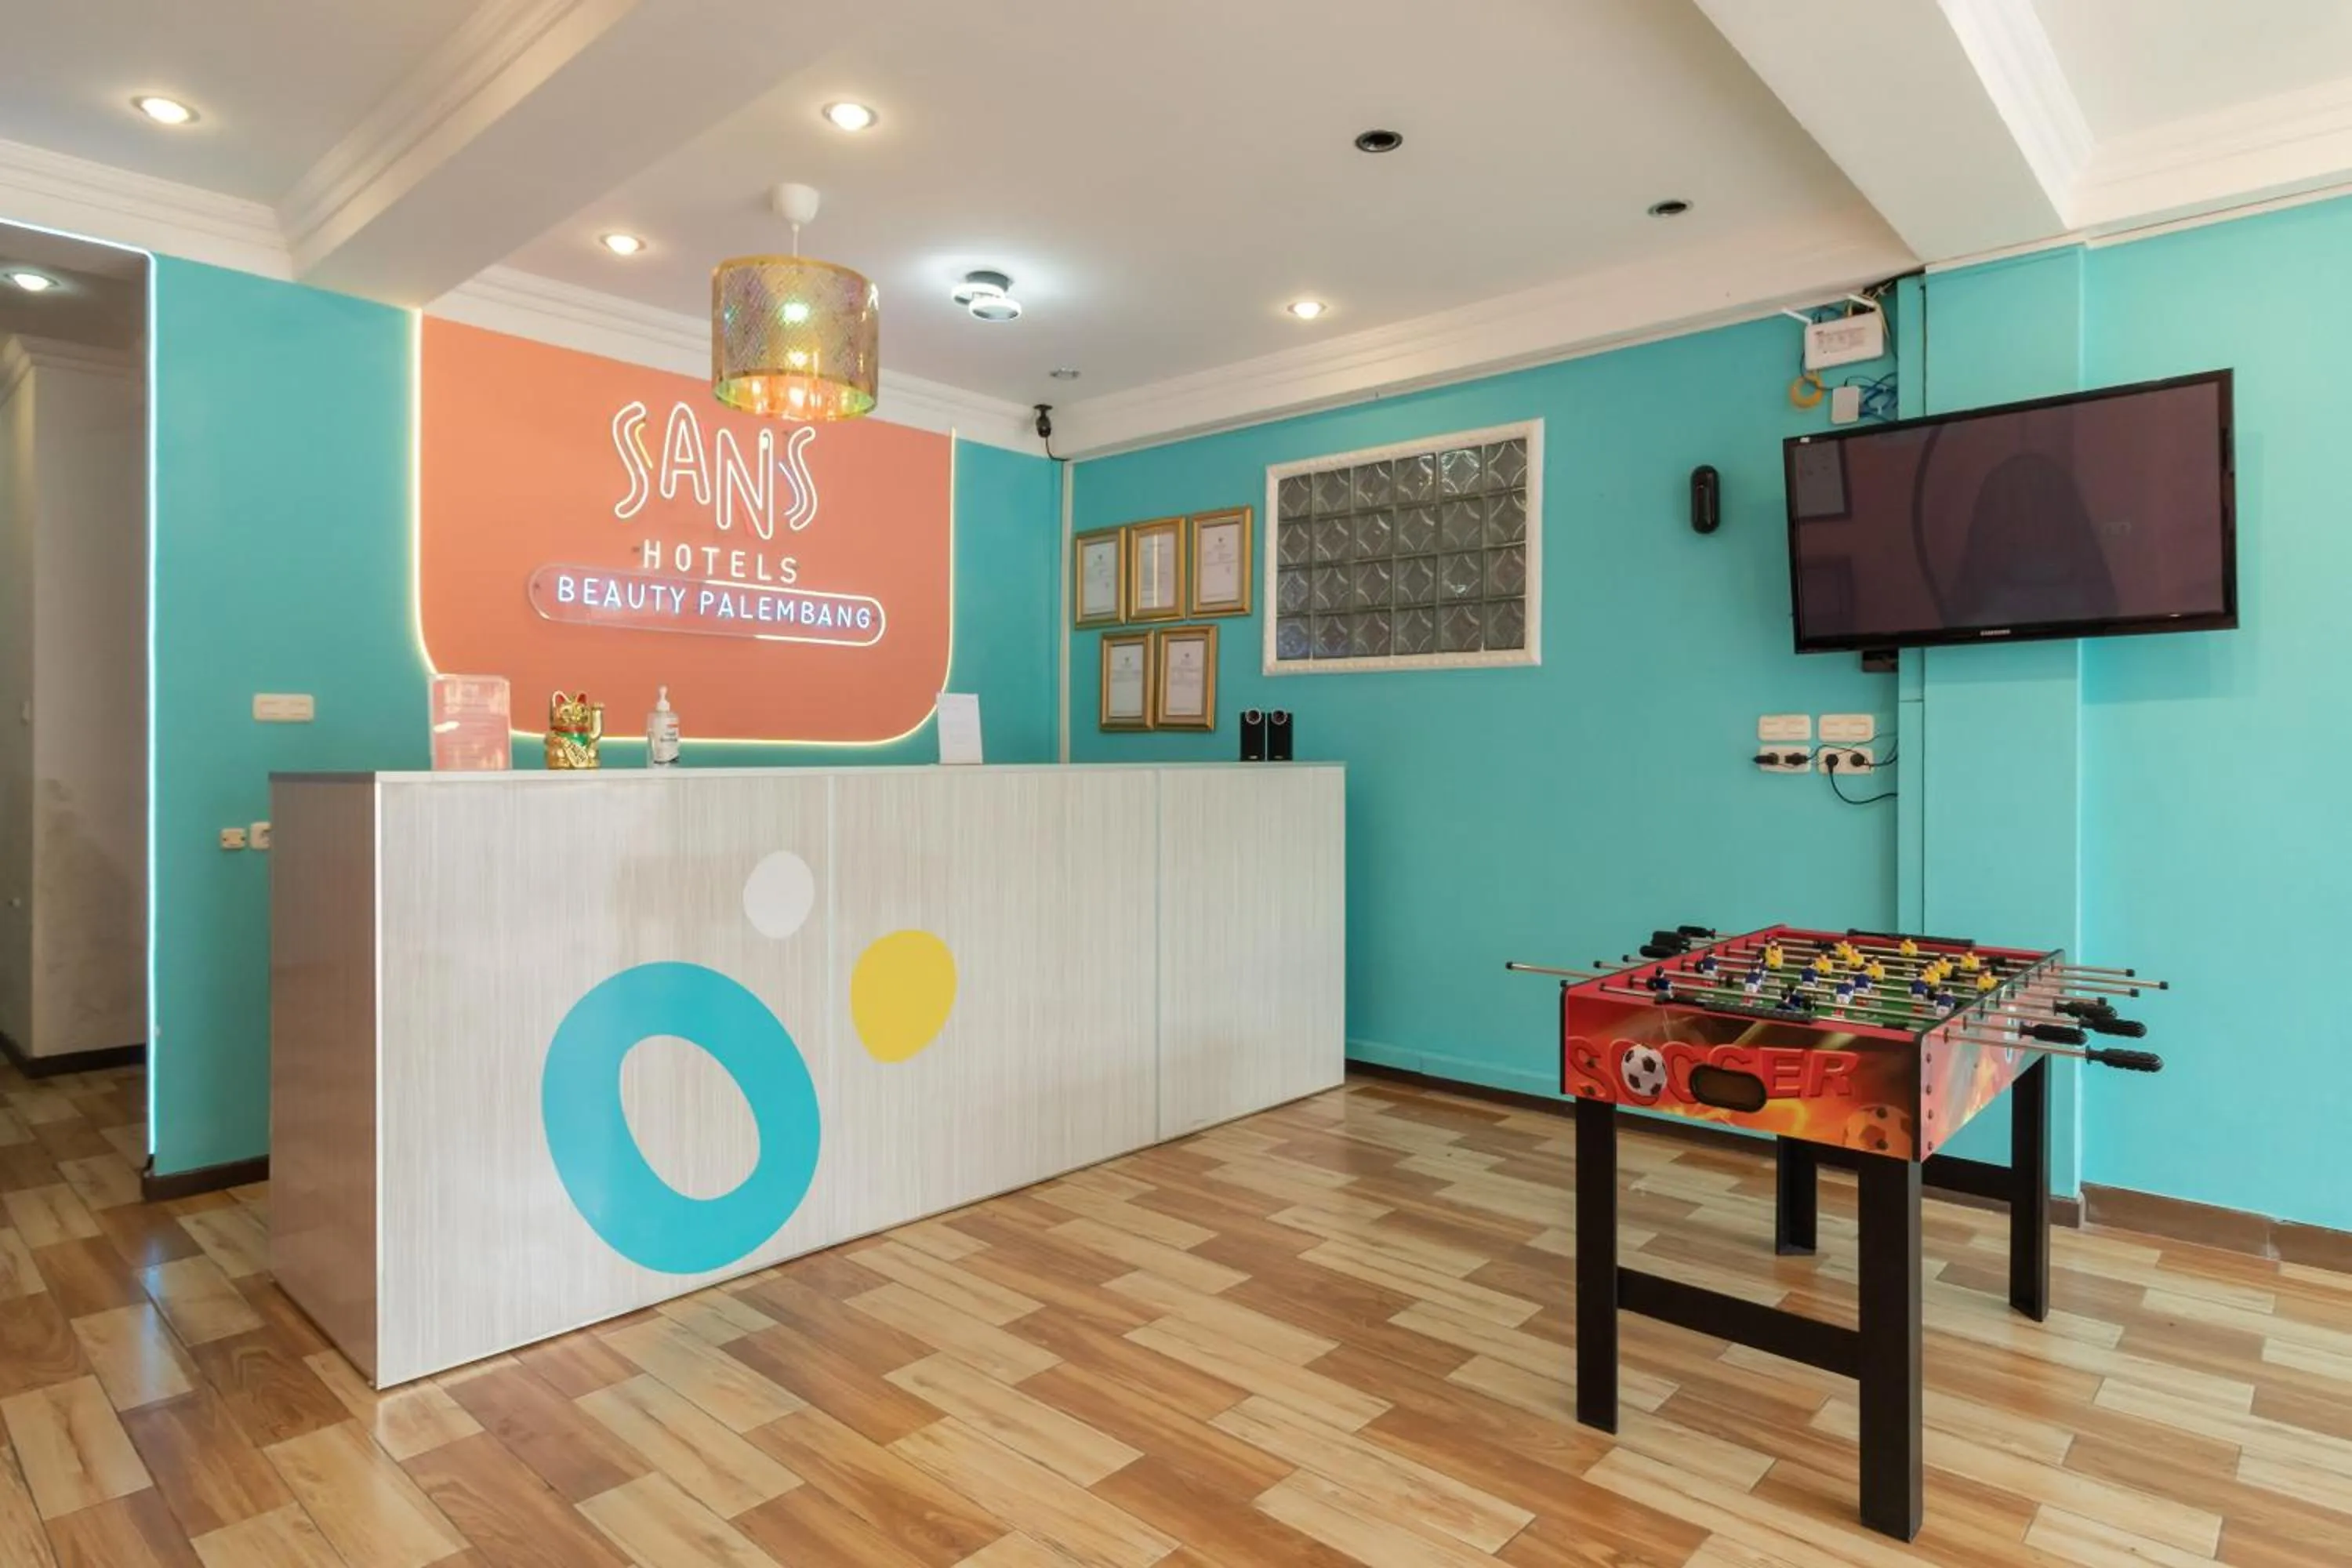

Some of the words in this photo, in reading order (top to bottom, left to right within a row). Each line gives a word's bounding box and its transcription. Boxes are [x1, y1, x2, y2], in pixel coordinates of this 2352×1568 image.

[612, 401, 818, 539] SANS
[643, 539, 798, 583] HOTELS
[557, 575, 687, 614] BEAUTY
[699, 590, 872, 630] PALEMBANG
